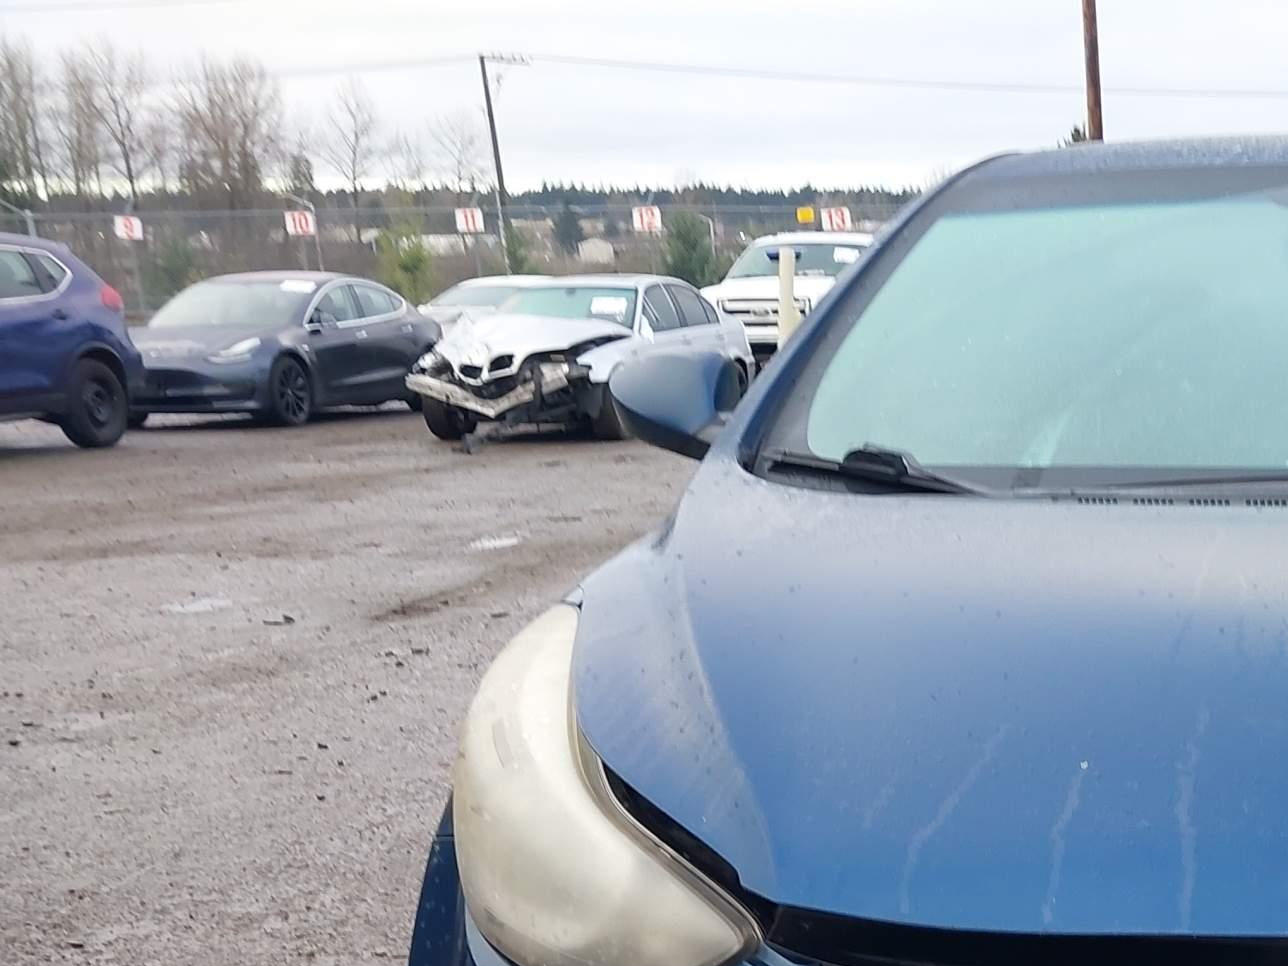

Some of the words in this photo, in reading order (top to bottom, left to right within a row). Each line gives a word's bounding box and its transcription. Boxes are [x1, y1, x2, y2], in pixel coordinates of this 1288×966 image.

[292, 212, 310, 235] 10
[464, 208, 480, 232] 11
[639, 206, 655, 230] 12
